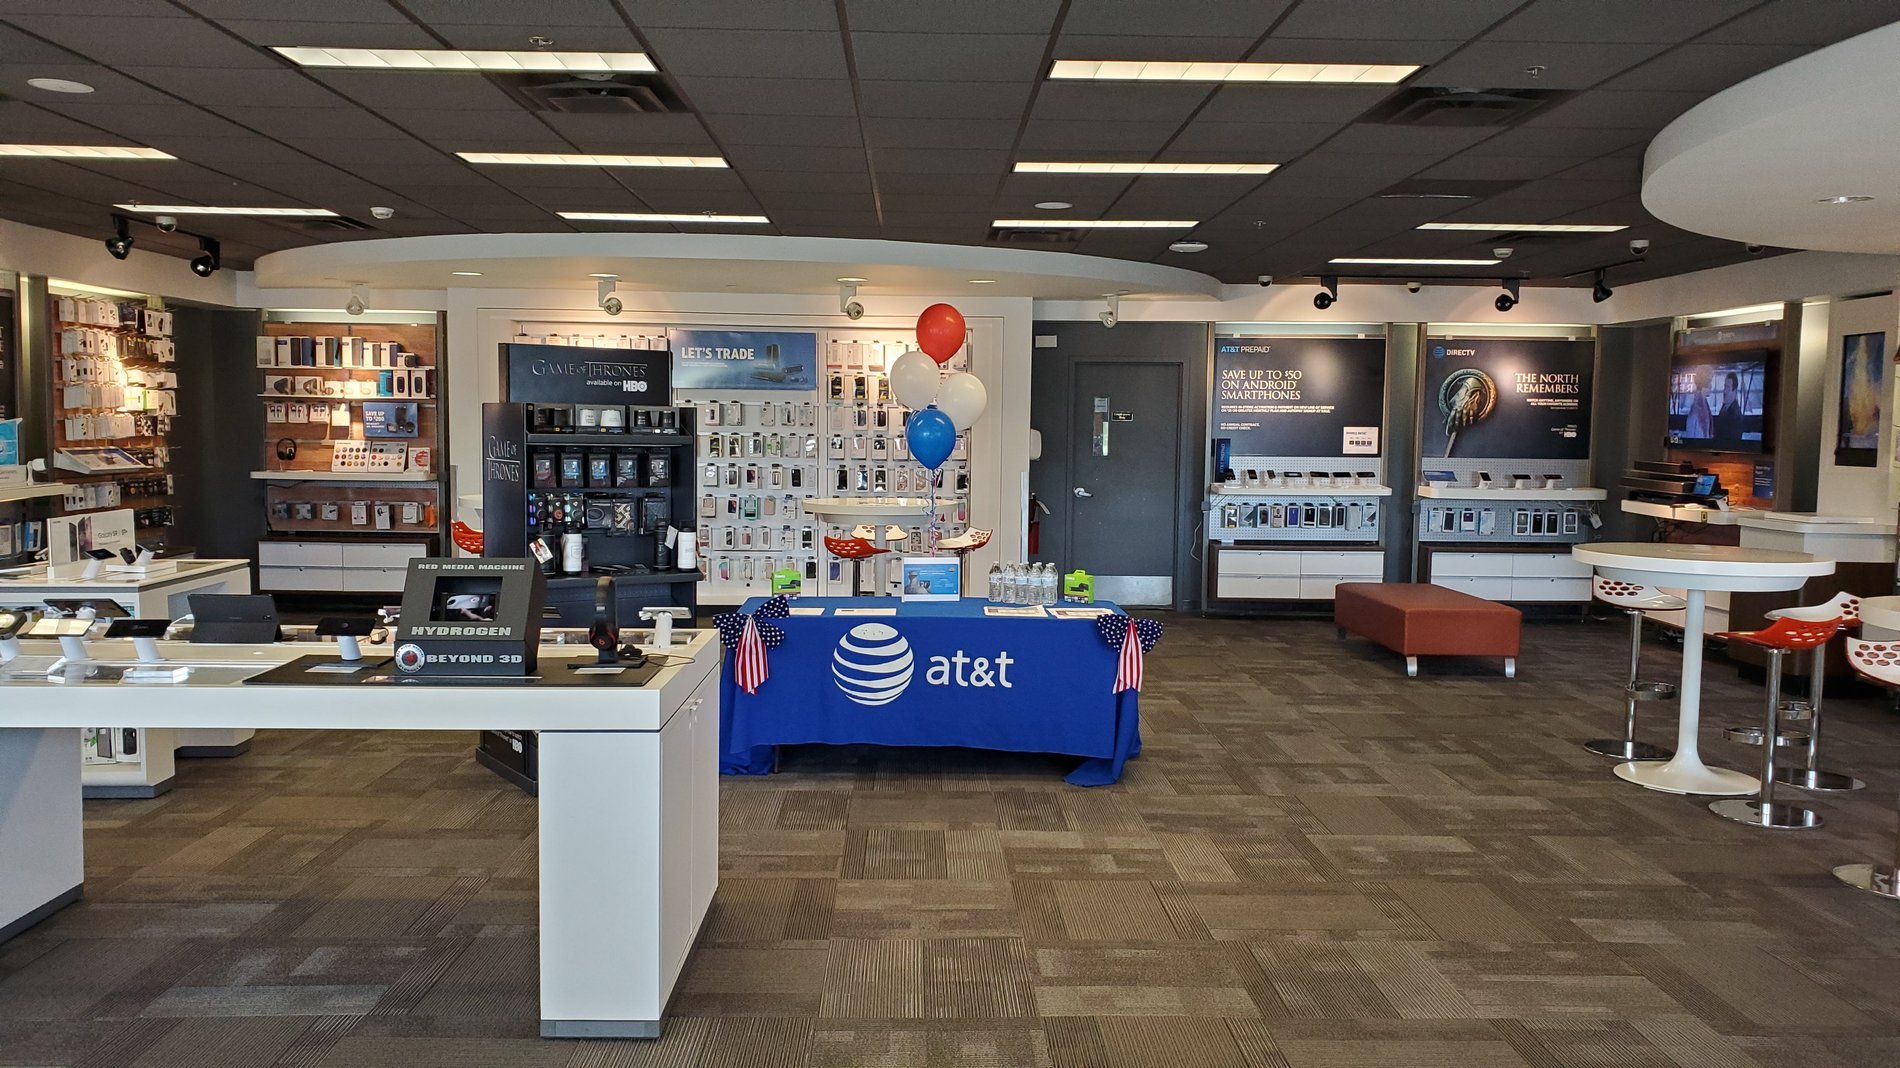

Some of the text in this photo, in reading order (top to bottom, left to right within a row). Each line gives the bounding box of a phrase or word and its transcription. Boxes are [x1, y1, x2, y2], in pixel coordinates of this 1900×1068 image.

[682, 348, 754, 360] LET'S TRADE
[532, 360, 574, 376] GAME
[584, 361, 648, 377] THRONES
[1222, 370, 1302, 380] SAVE UP TO $50
[1515, 373, 1579, 383] THE NORTH
[623, 380, 648, 392] HBO
[1222, 380, 1296, 390] ON ANDROID
[1516, 384, 1579, 394] REMEMBERS
[1221, 390, 1301, 400] SMARTPHONES
[488, 435, 510, 458] GAME
[486, 458, 520, 481] THRONES
[411, 626, 511, 636] HYDROGEN
[426, 655, 522, 663] BEYOND 3D
[926, 650, 1014, 688] at&t
